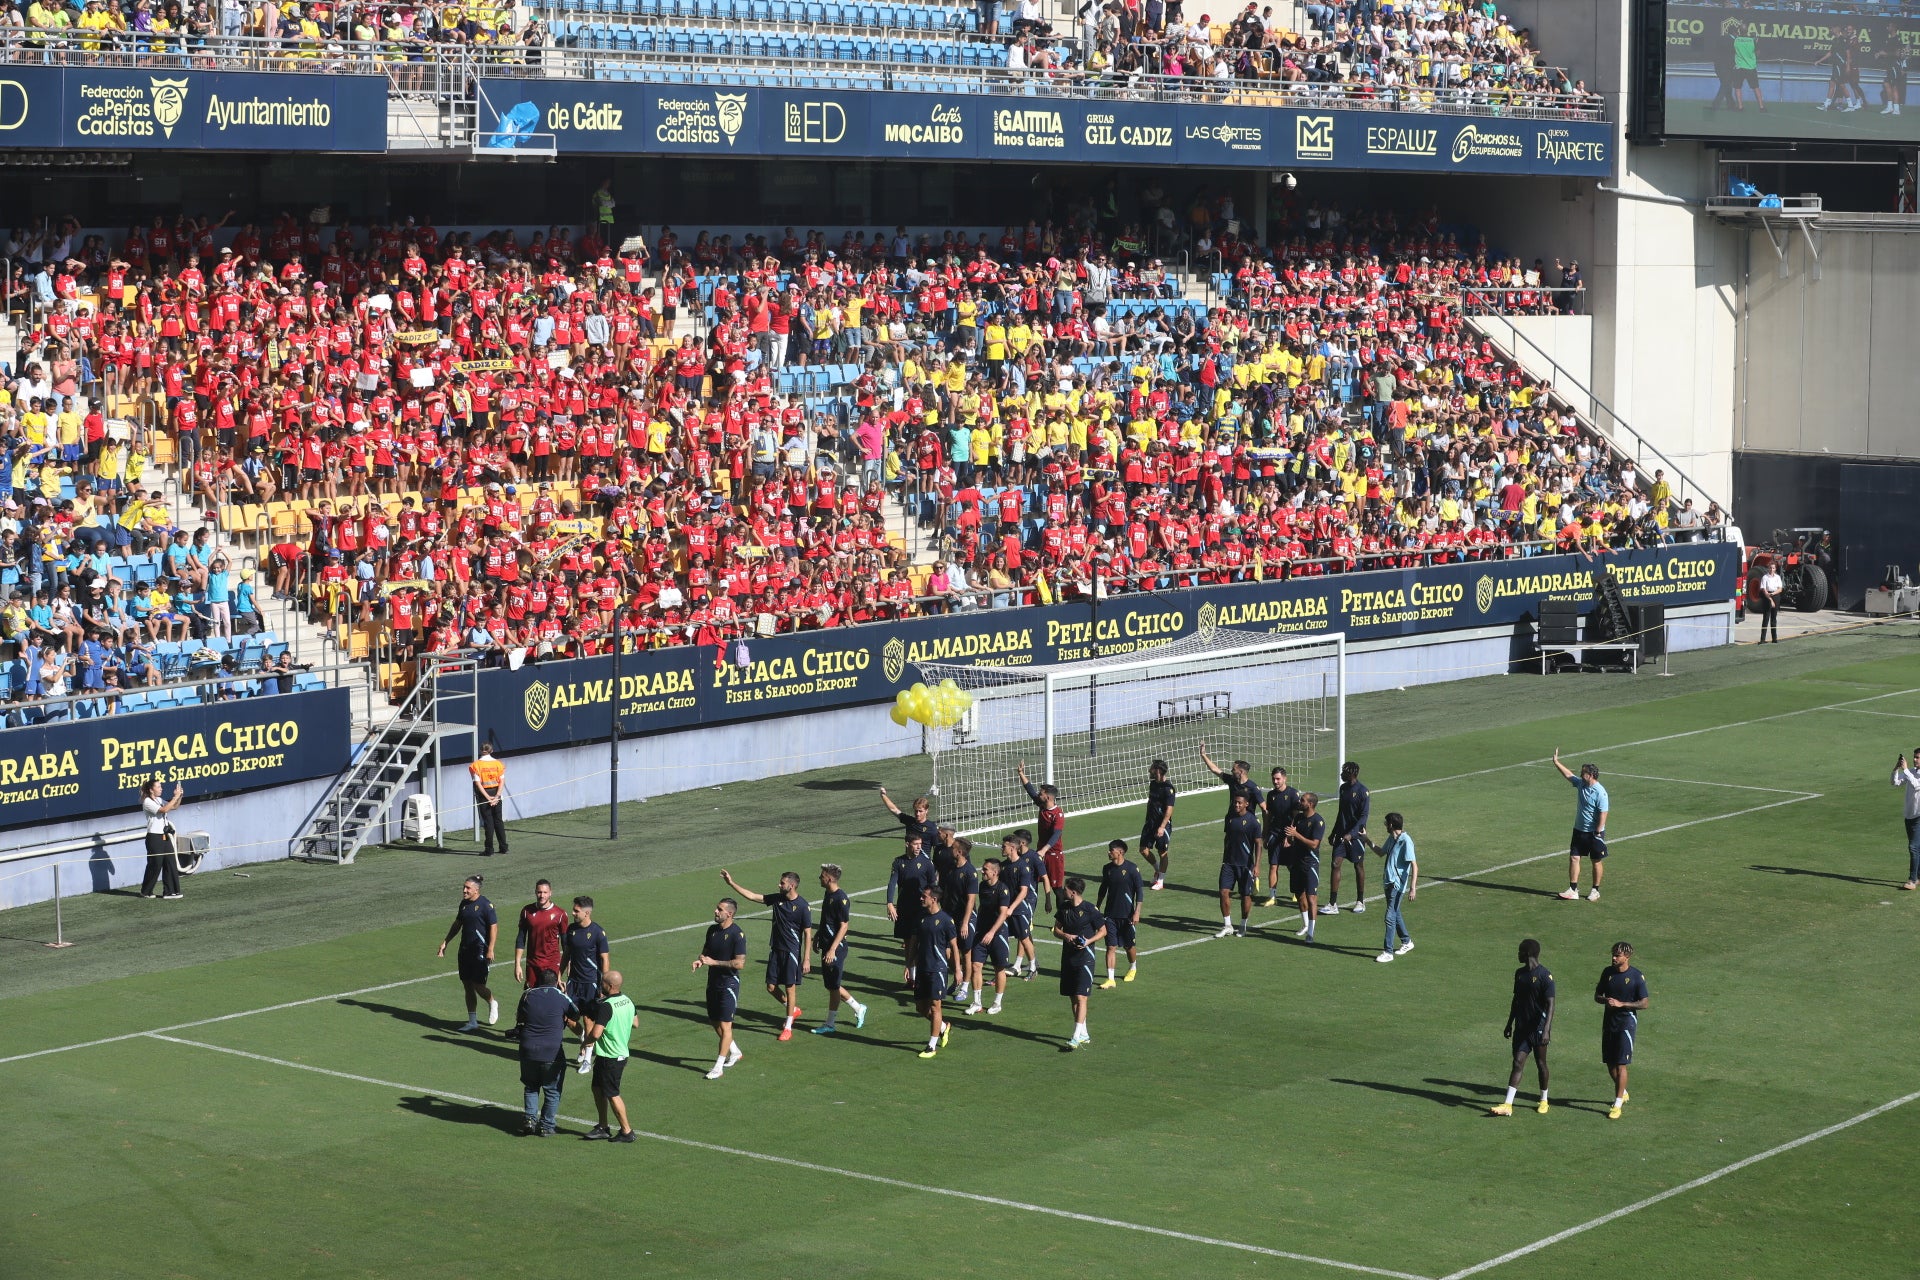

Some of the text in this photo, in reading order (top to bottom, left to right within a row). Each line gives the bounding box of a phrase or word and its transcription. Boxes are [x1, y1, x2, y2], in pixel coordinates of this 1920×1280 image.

[80, 85, 143, 99] Federación
[89, 98, 151, 118] de Peñas
[206, 95, 331, 131] Ayuntamiento
[658, 98, 710, 112] Federación
[931, 104, 962, 126] Cafés
[77, 114, 154, 136] Cadistas
[547, 102, 623, 131] de Cádiz
[665, 110, 716, 128] de Peñas
[999, 109, 1064, 133] GAMMA
[1087, 114, 1115, 124] GRUAS
[656, 125, 720, 144] Cadistas
[994, 132, 1065, 147] Hnos García
[1085, 125, 1173, 146] GIL CADIZ
[1185, 126, 1262, 142] LAS CORTES
[1367, 127, 1437, 151] ESPALUZ
[1474, 133, 1508, 145] CHICHOS
[1536, 132, 1605, 165] PAJARETE
[461, 361, 491, 370] CADIZ
[1667, 557, 1715, 578] CHICO
[1495, 571, 1593, 597] ALMADRABA
[1633, 586, 1640, 596] &
[1641, 584, 1676, 597] SEAFOOD
[1676, 581, 1706, 593] EXPORT
[1341, 583, 1463, 613] PETACA CHICO
[1218, 597, 1329, 626] ALMADRABA
[1350, 607, 1454, 627] FISH & SEAFOOD EXPORT
[1047, 611, 1184, 647] PETACA CHICO
[1277, 622, 1304, 633] PETACA
[1305, 620, 1328, 631] CHICO
[906, 630, 1032, 662] ALMADRABA
[1058, 648, 1080, 661] FISH
[1082, 646, 1091, 658] &
[1098, 642, 1135, 656] EAFOOD
[802, 647, 870, 675] CHICO
[1007, 654, 1033, 666] CHICO
[551, 670, 694, 709] ALMADRABA
[725, 675, 858, 704] FISH & SEAFOOD EXPORT
[630, 700, 665, 715] PETACA
[667, 697, 696, 709] CHICO
[101, 720, 299, 772] PETACA CHICO
[118, 753, 284, 790] FISH & SEAFOOD EXPORT
[42, 782, 79, 799] CHICO
